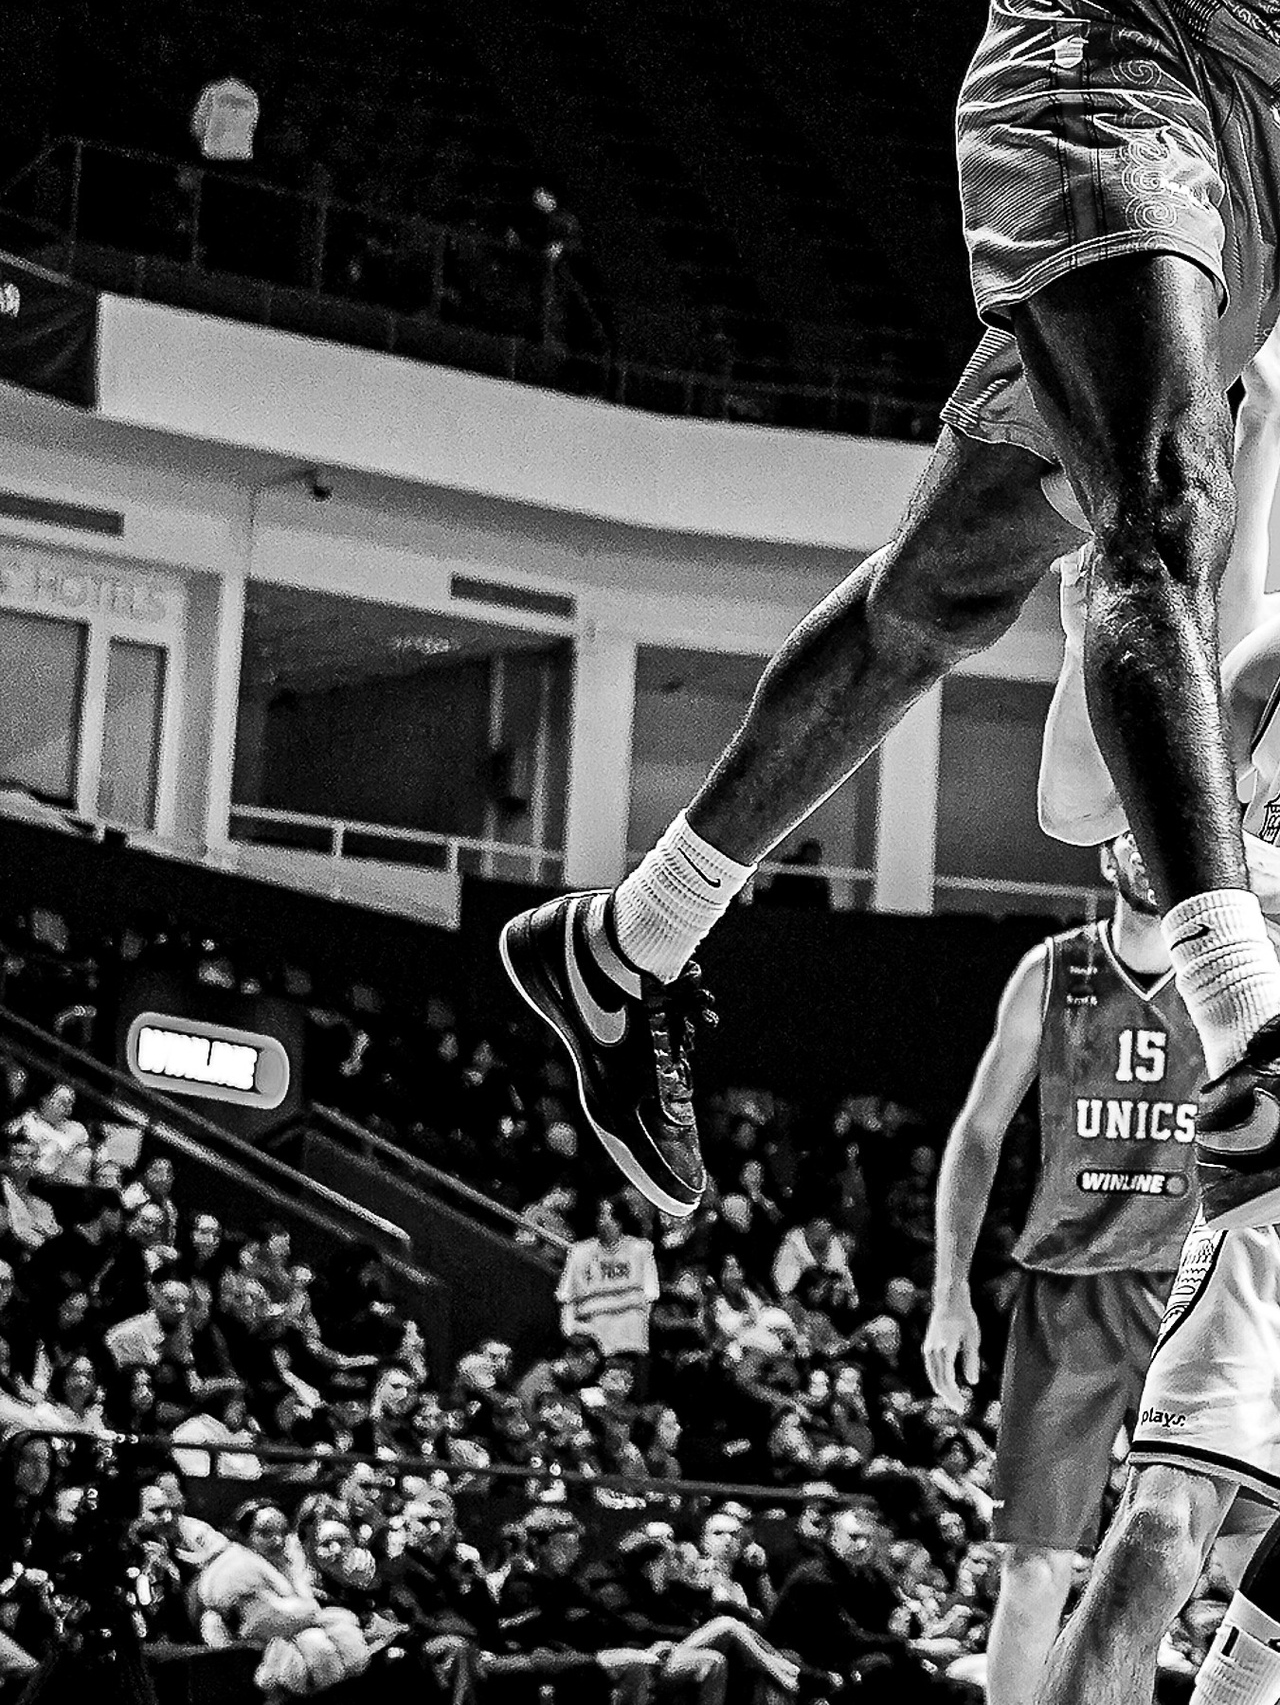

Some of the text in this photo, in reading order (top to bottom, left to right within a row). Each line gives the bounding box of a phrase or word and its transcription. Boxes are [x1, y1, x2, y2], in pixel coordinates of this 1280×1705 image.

[1115, 1028, 1168, 1082] 15
[1076, 1098, 1199, 1144] UNICS
[1081, 1171, 1166, 1194] WINLINE
